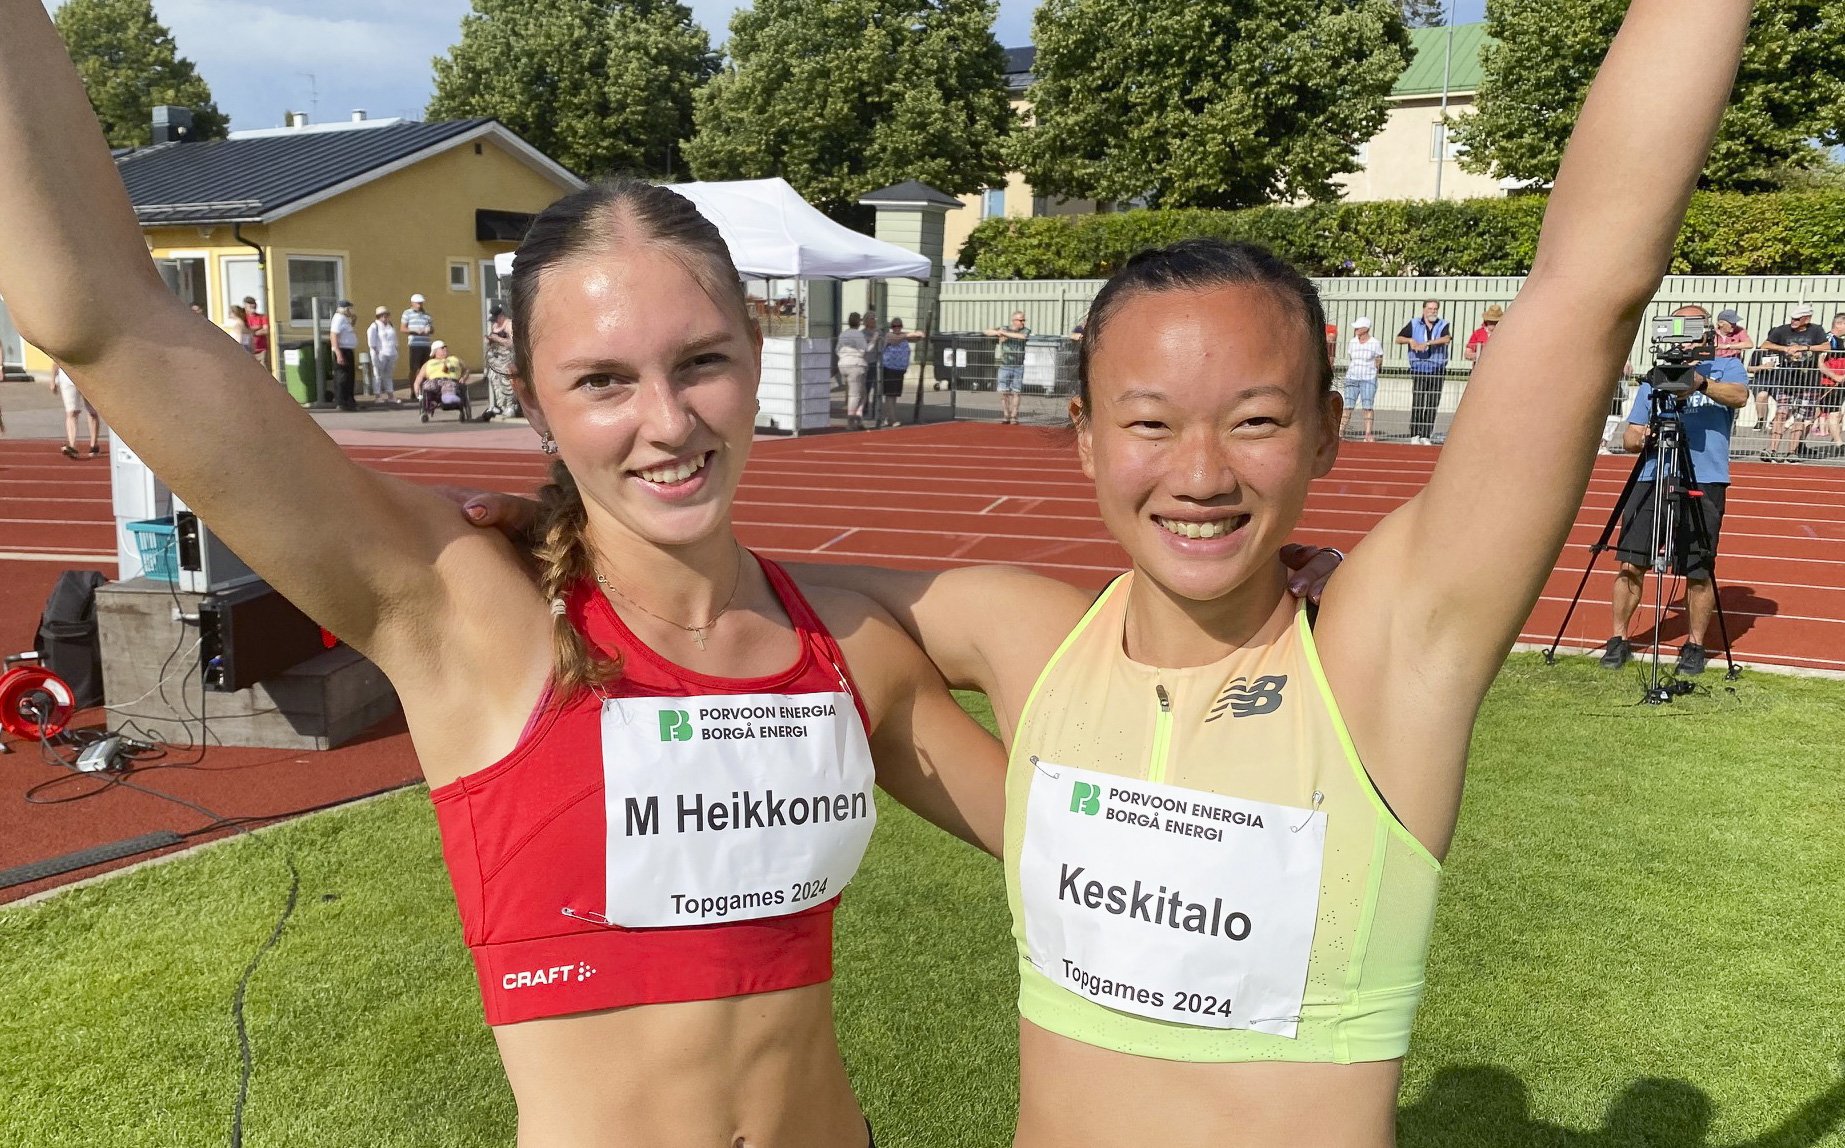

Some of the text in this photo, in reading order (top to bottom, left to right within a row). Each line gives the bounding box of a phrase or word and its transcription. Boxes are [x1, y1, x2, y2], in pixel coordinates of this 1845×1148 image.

[700, 704, 836, 721] PORVOON ENERGIA
[701, 722, 808, 740] BORGÅ ENERGI
[626, 788, 867, 837] M Heikkonen
[1105, 807, 1224, 843] BORGÅ ENERGI
[1109, 787, 1265, 829] PORVOON ENERGIA
[671, 877, 829, 918] Topgames 2024
[1058, 863, 1253, 942] Keskitalo
[502, 964, 574, 990] CRAFT
[1062, 958, 1233, 1018] Topgames 2024
